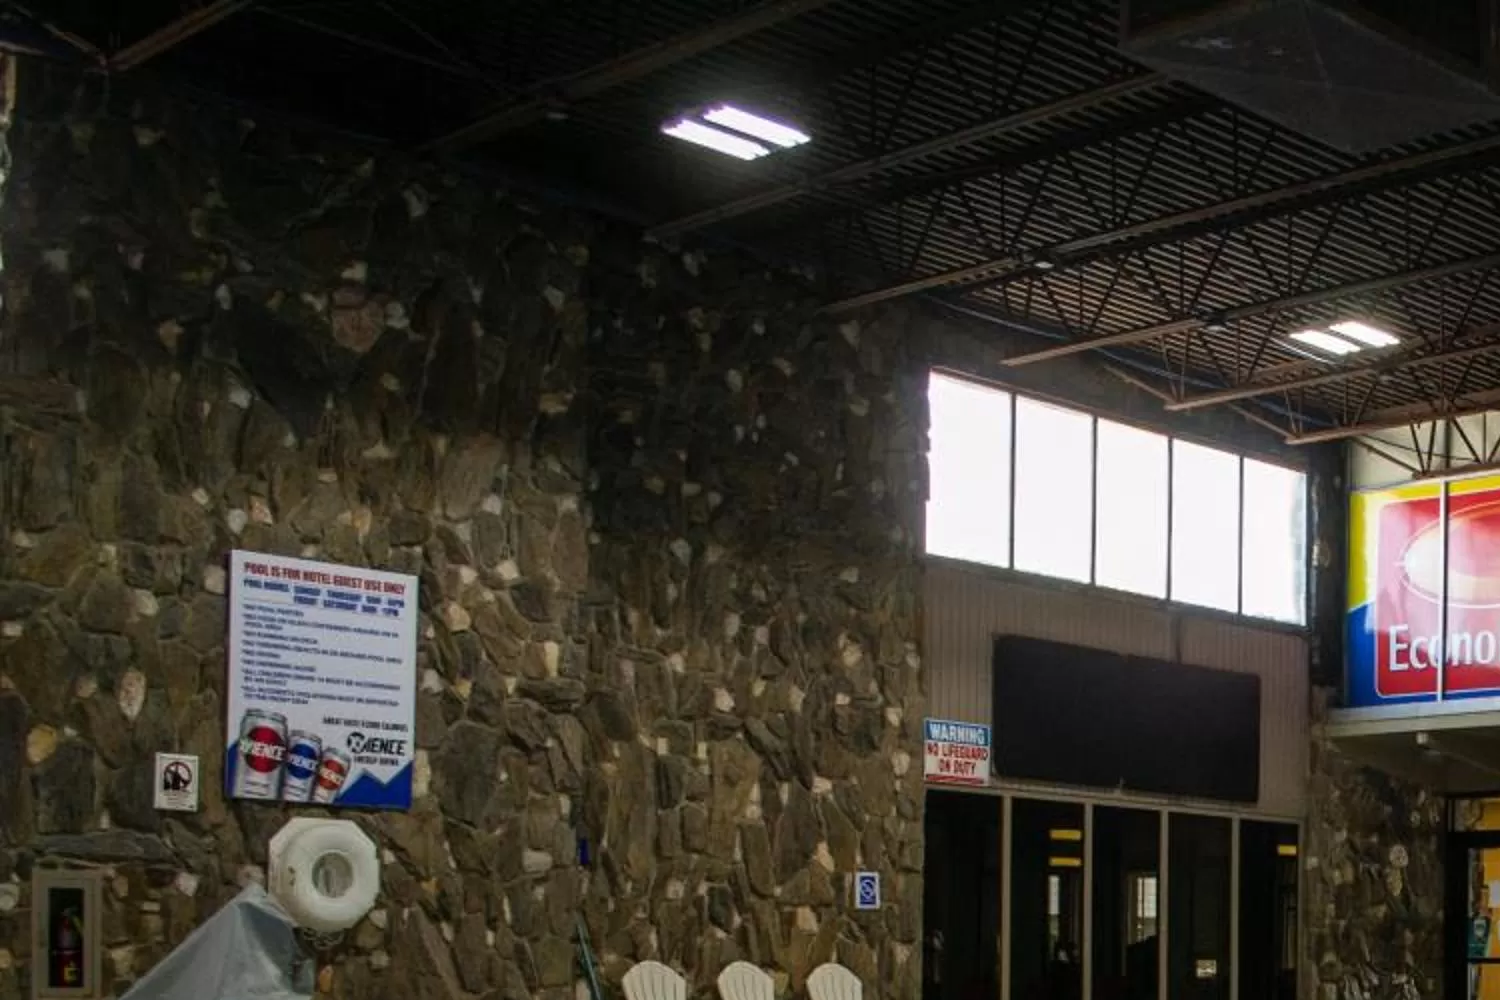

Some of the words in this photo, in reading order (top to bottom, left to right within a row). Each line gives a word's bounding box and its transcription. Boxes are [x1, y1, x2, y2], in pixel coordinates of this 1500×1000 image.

[929, 723, 985, 746] WARNING
[927, 742, 939, 757] NO
[942, 744, 989, 761] LIFEGUARD
[939, 759, 951, 773] ON
[953, 760, 977, 776] DUTY
